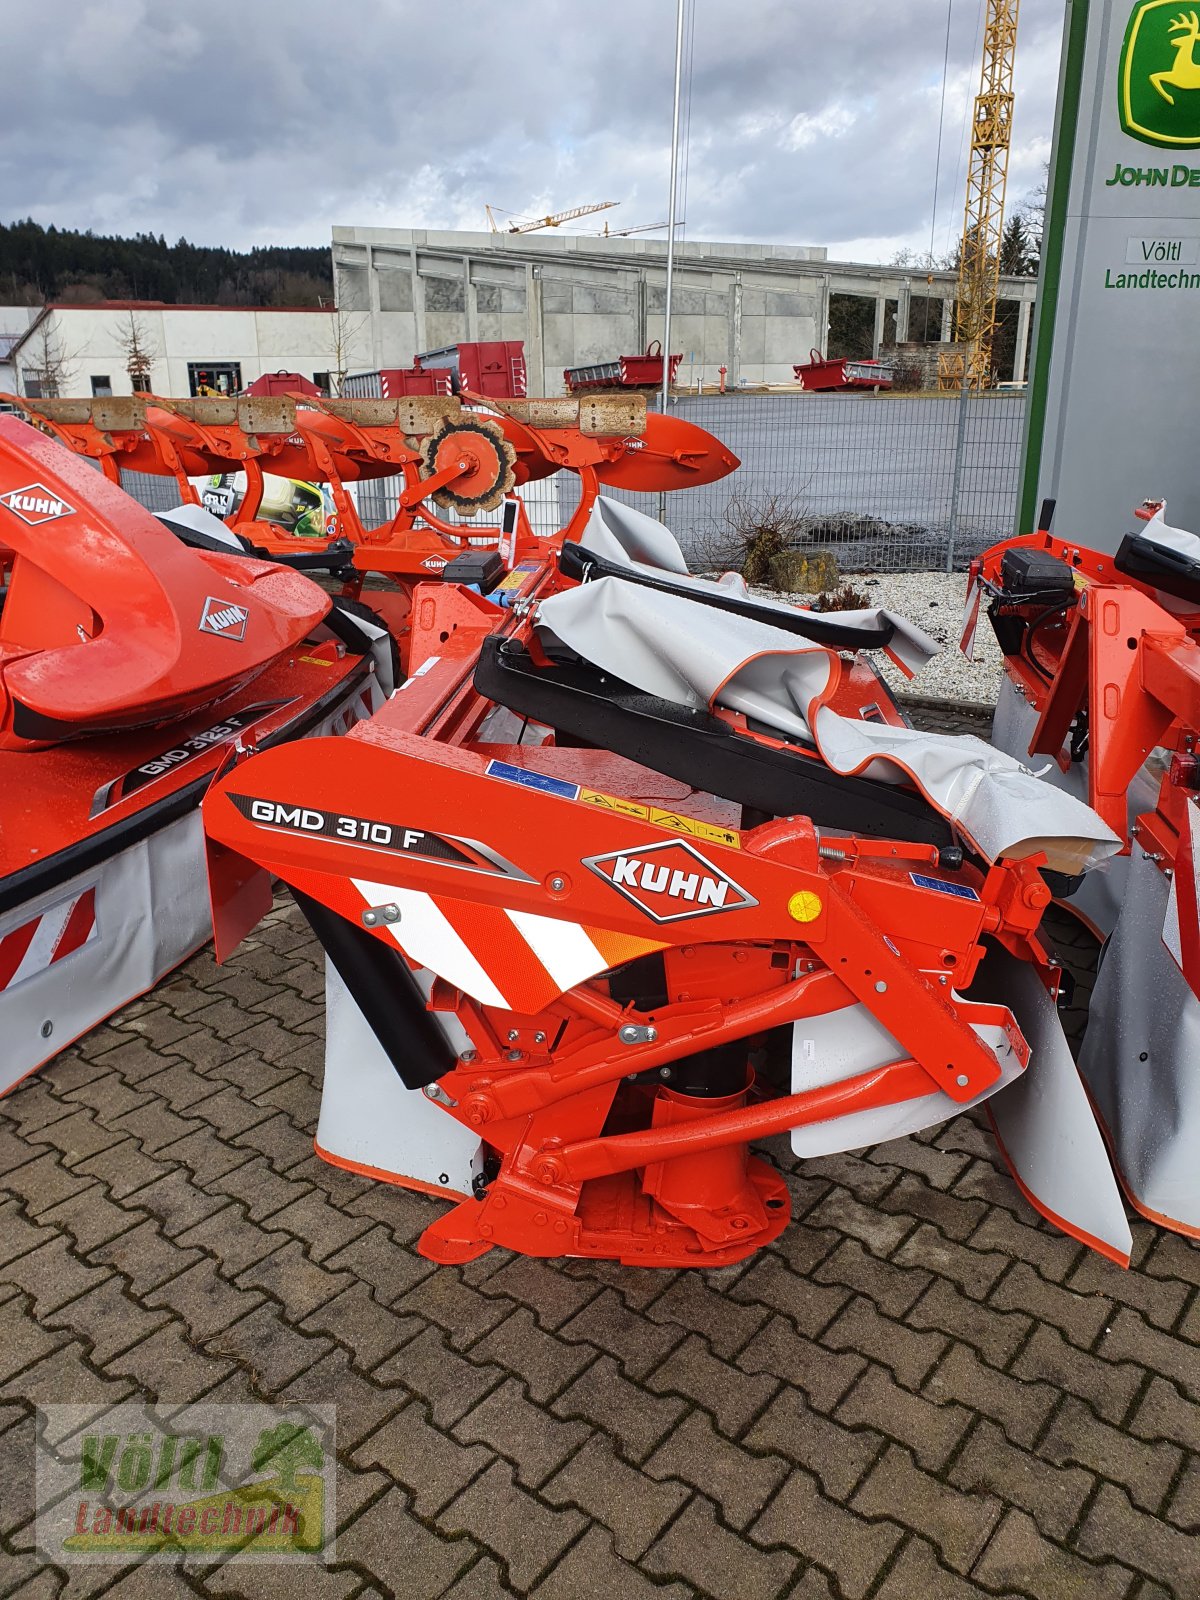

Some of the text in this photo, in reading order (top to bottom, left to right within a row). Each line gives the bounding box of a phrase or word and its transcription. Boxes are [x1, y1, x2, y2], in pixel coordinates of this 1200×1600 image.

[1105, 163, 1169, 187] JOHN
[1141, 240, 1182, 261] Völtl
[9, 494, 63, 515] KUHN
[205, 605, 246, 631] KUHN
[138, 717, 243, 775] GMD 3125 F
[251, 800, 425, 848] GMD 310 F
[612, 856, 729, 908] KUHN
